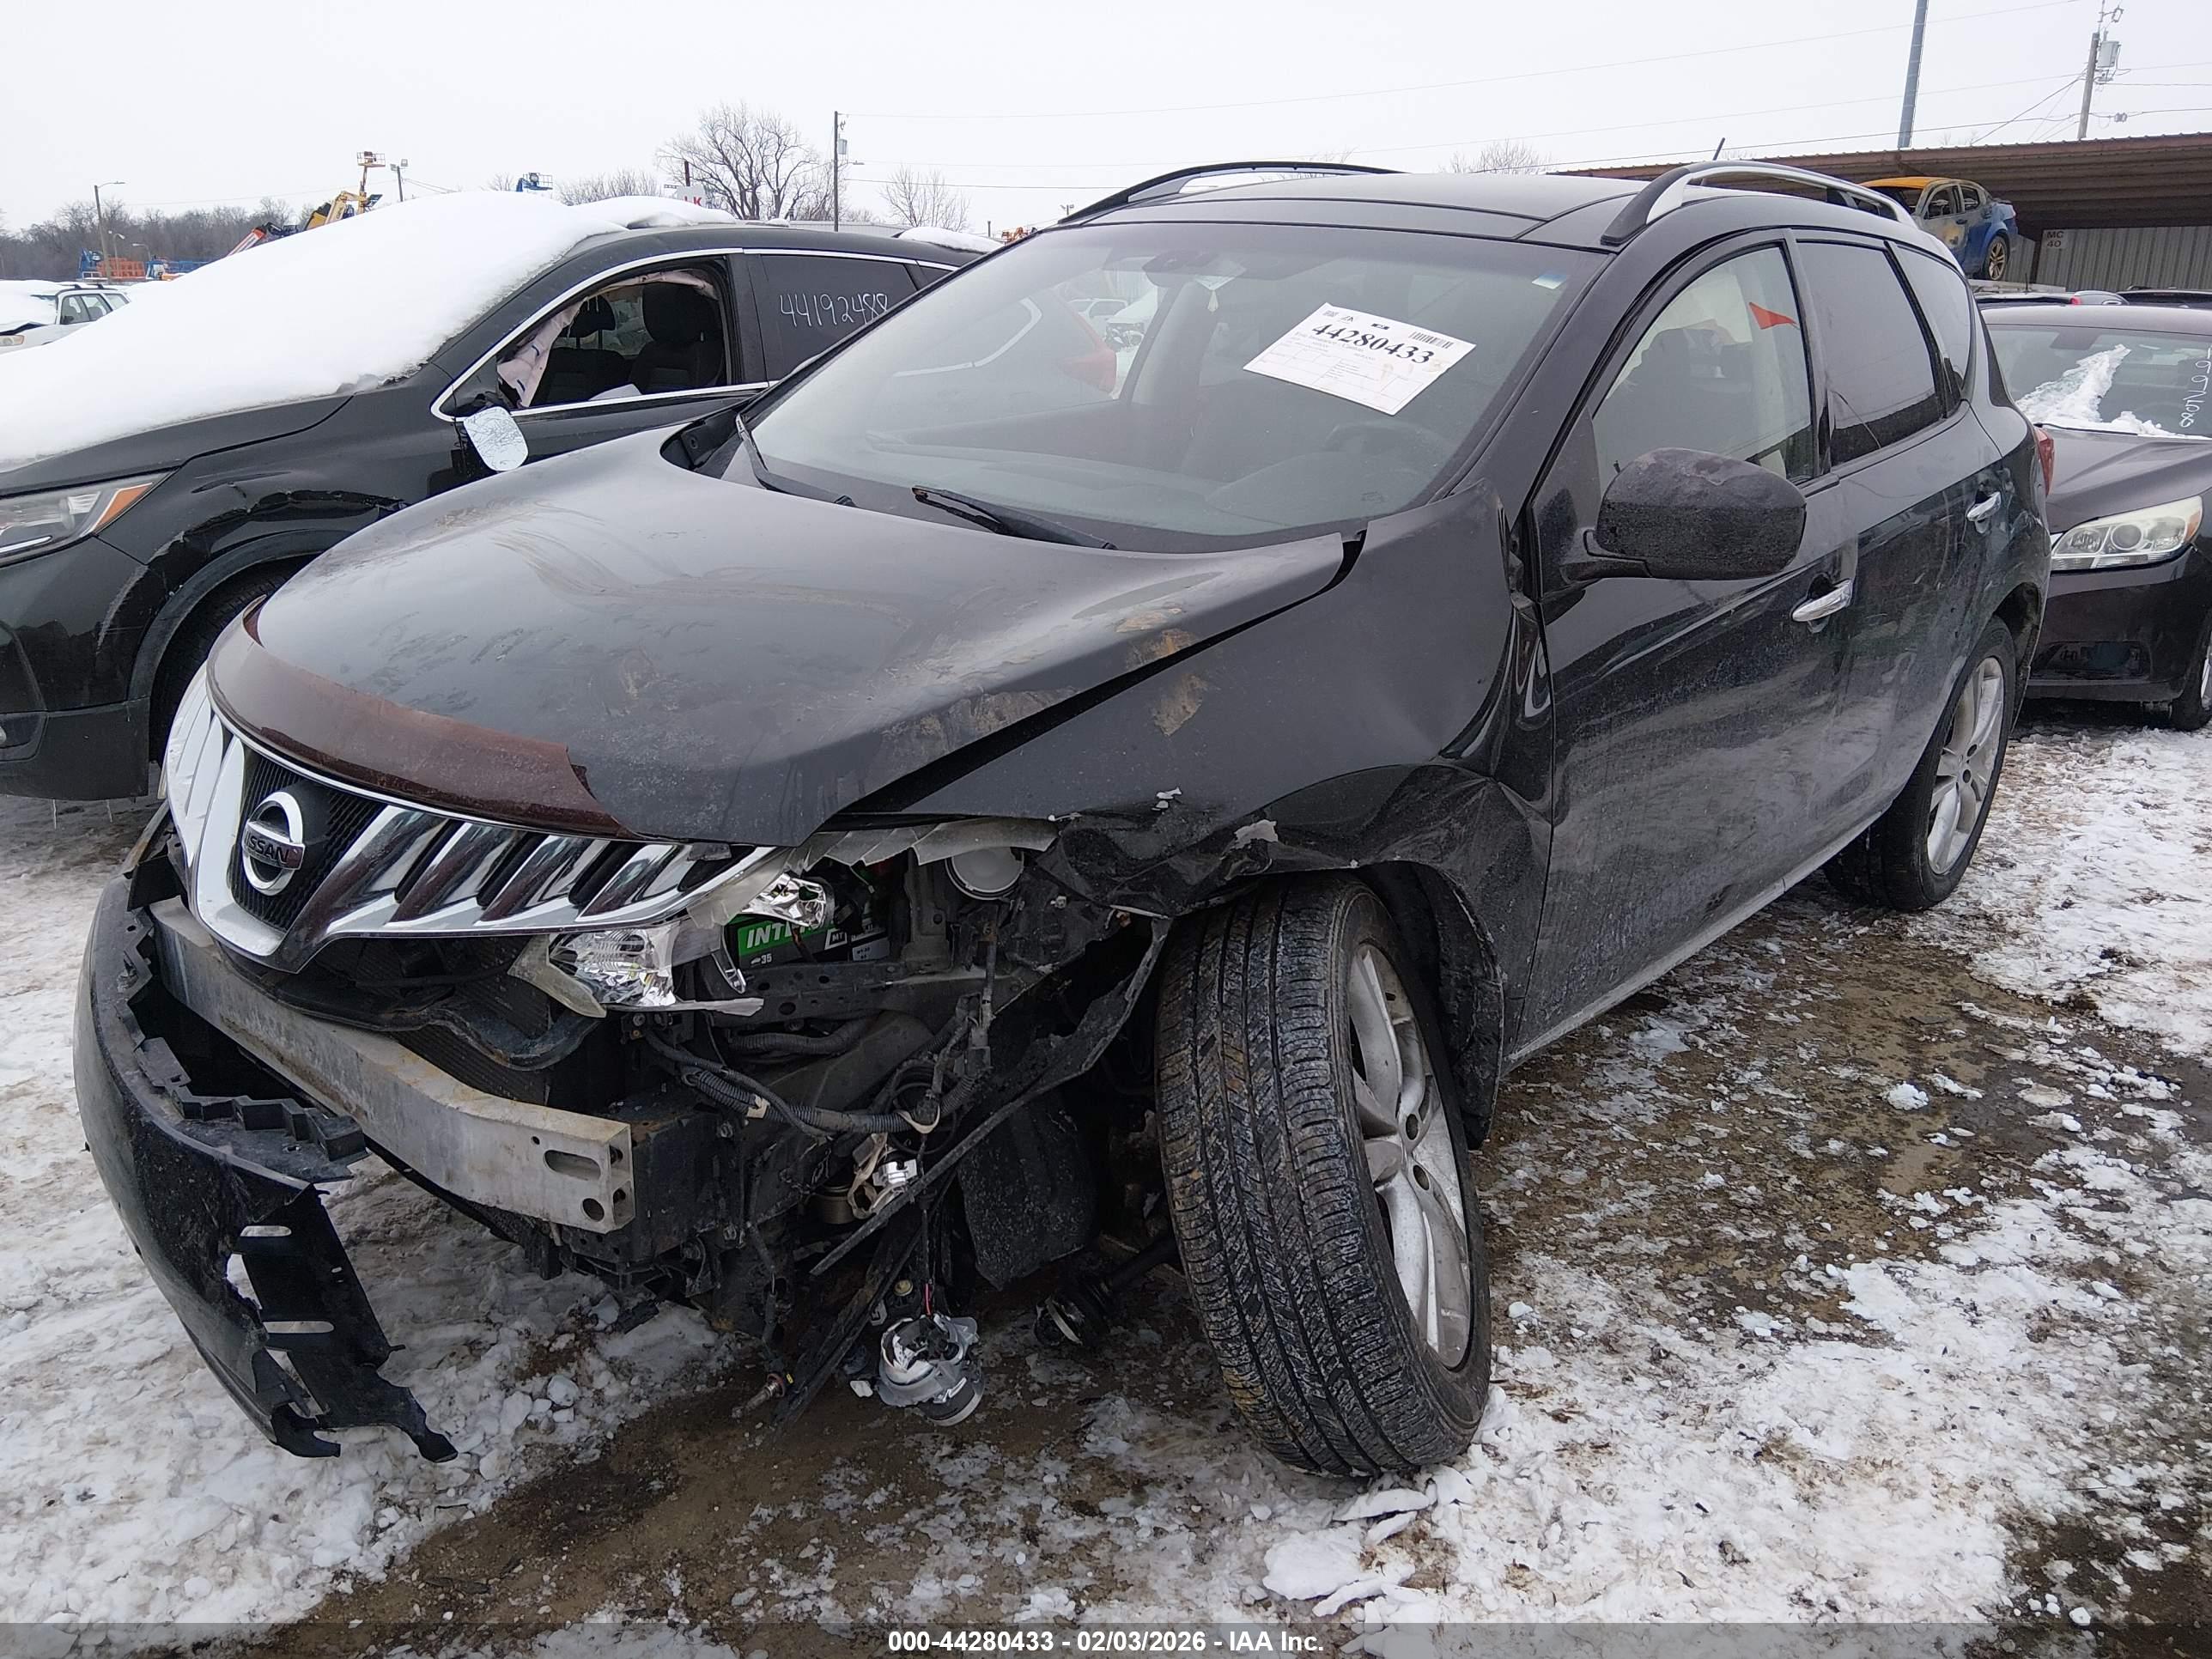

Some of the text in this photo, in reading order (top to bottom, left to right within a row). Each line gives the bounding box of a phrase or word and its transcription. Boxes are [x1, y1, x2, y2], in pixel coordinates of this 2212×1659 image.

[2046, 240, 2062, 248] 40
[1311, 323, 1436, 364] 44280433
[760, 953, 773, 965] 35
